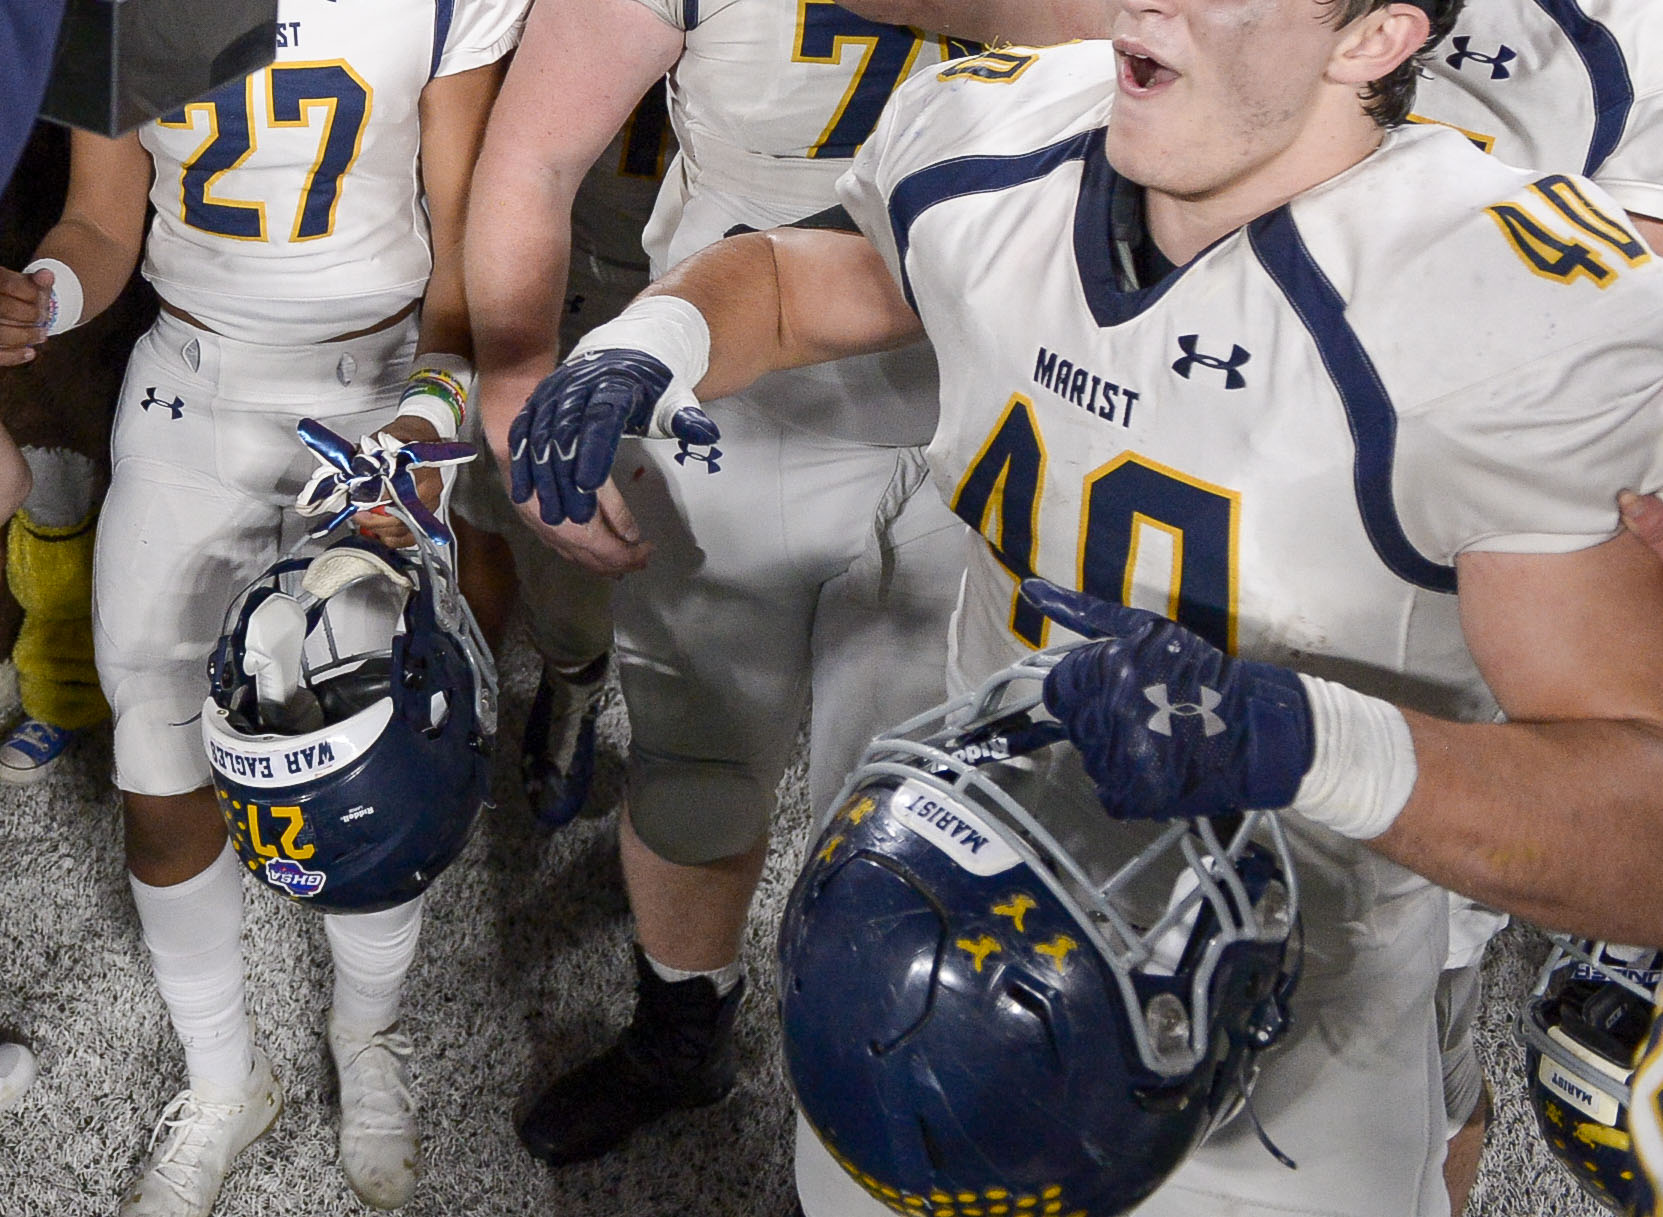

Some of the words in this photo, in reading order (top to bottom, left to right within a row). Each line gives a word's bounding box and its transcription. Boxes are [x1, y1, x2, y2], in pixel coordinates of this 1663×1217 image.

[156, 57, 374, 243] 27
[1481, 174, 1652, 291] 40
[1034, 347, 1140, 429] MARIST
[950, 392, 1242, 657] 40
[210, 740, 274, 779] EAGLES
[285, 740, 335, 775] WAR
[247, 804, 316, 860] 27
[906, 795, 989, 855] MARIST
[270, 869, 323, 887] GHSA
[1551, 1071, 1593, 1107] MARIST
